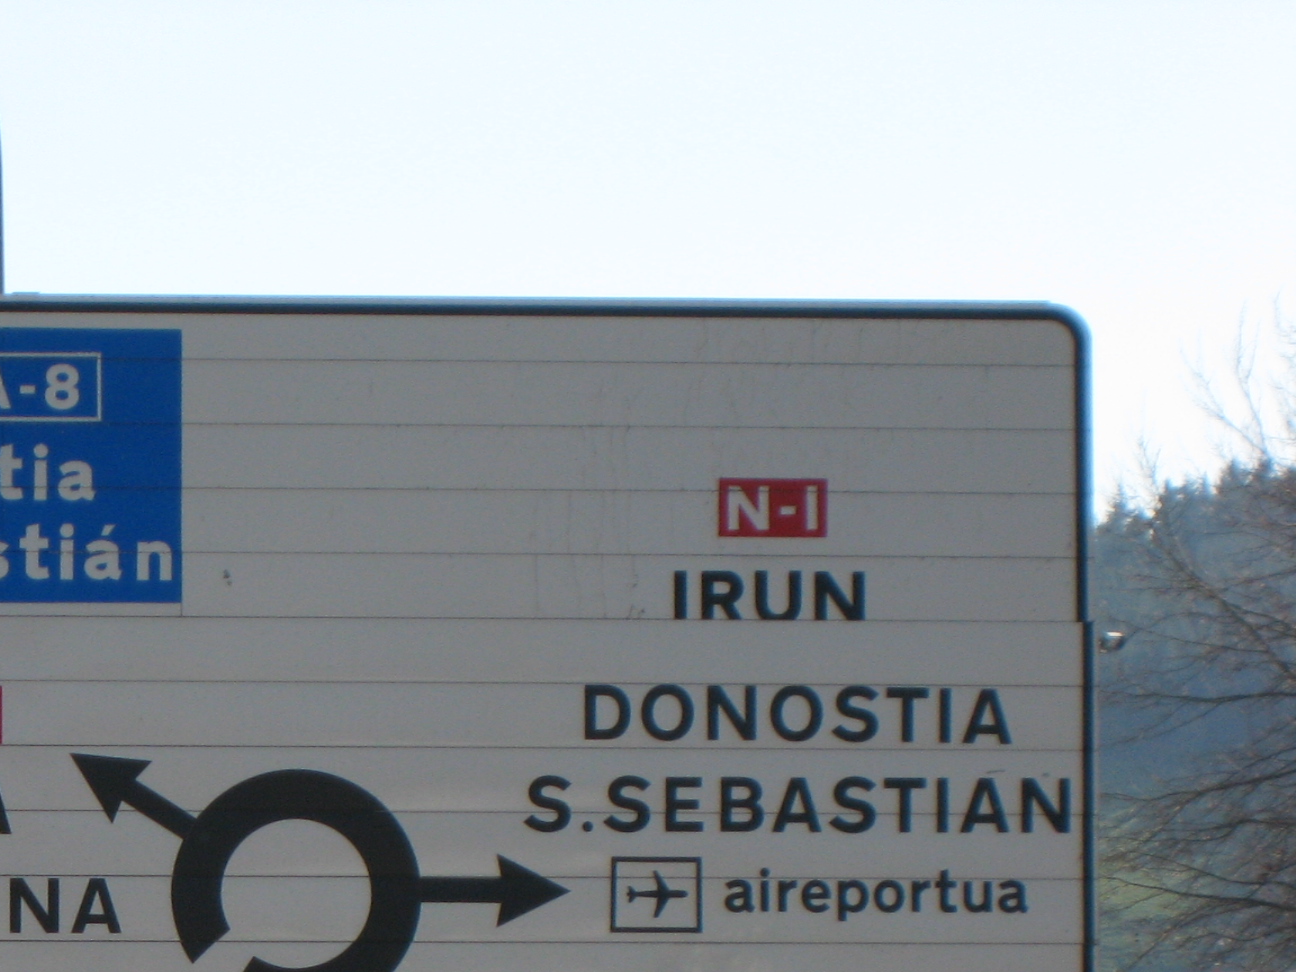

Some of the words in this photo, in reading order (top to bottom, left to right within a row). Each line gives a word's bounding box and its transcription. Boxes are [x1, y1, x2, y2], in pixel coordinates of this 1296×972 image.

[673, 570, 867, 621] IRUN
[583, 683, 1013, 745] DONOSTIA
[724, 867, 1029, 922] aireportua
